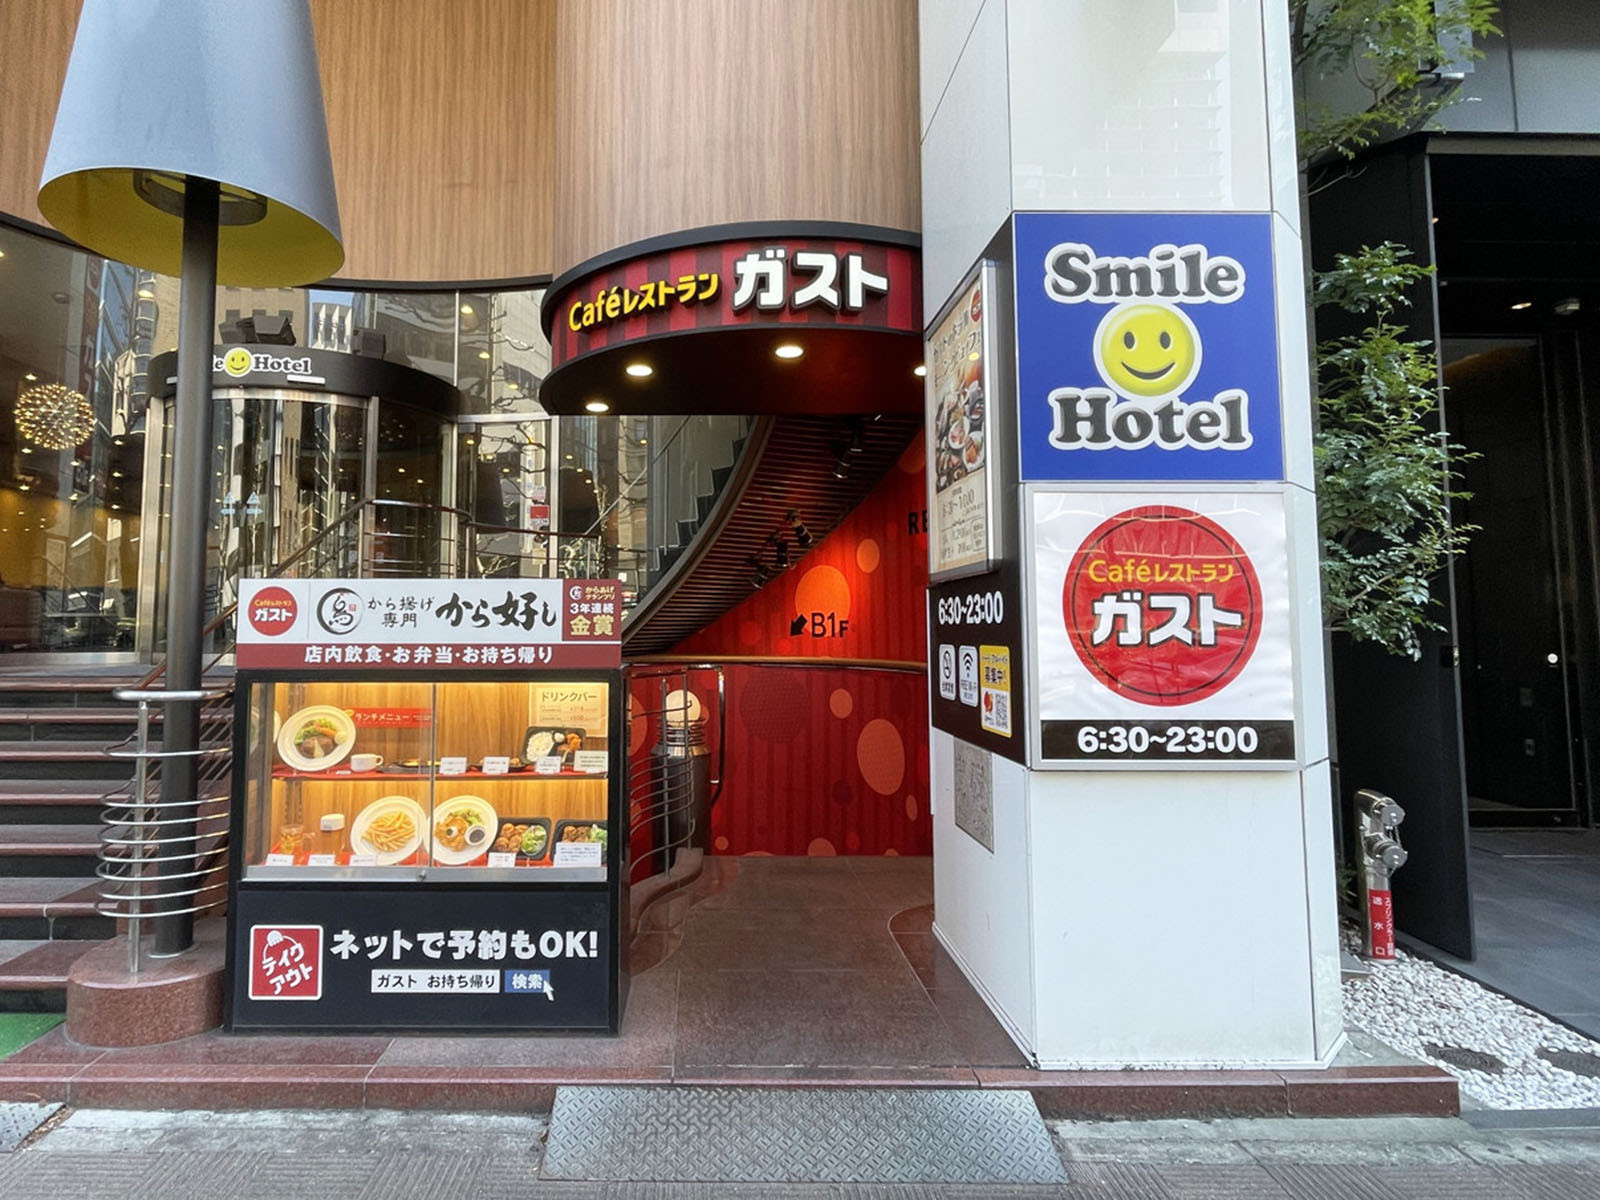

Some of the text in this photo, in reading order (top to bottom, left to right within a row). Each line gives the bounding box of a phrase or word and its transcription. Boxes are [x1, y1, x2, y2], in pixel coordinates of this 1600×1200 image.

[733, 248, 889, 309] ガスト
[1047, 245, 1243, 301] Smile
[568, 272, 719, 332] Caféレストラン
[252, 354, 311, 374] Hotel
[1050, 390, 1250, 447] Hotel
[1088, 558, 1235, 583] Caféレストラン
[254, 607, 293, 622] ガスト
[367, 595, 435, 612] から揚げ
[435, 590, 557, 632] から好し
[938, 590, 1004, 625] 6:30~23:00
[381, 612, 418, 629] 専門
[569, 614, 615, 636] 金賞
[811, 612, 849, 638] B1F
[1091, 590, 1243, 647] ガスト
[542, 691, 598, 702] ドリンクバー
[1077, 726, 1258, 753] 6:30~23:00
[330, 930, 599, 961] ネットで予約もOK!
[262, 943, 305, 977] テイク
[269, 963, 313, 995] アウト
[377, 974, 496, 988] ガスト お持ち帰り
[512, 973, 543, 989] 検索
